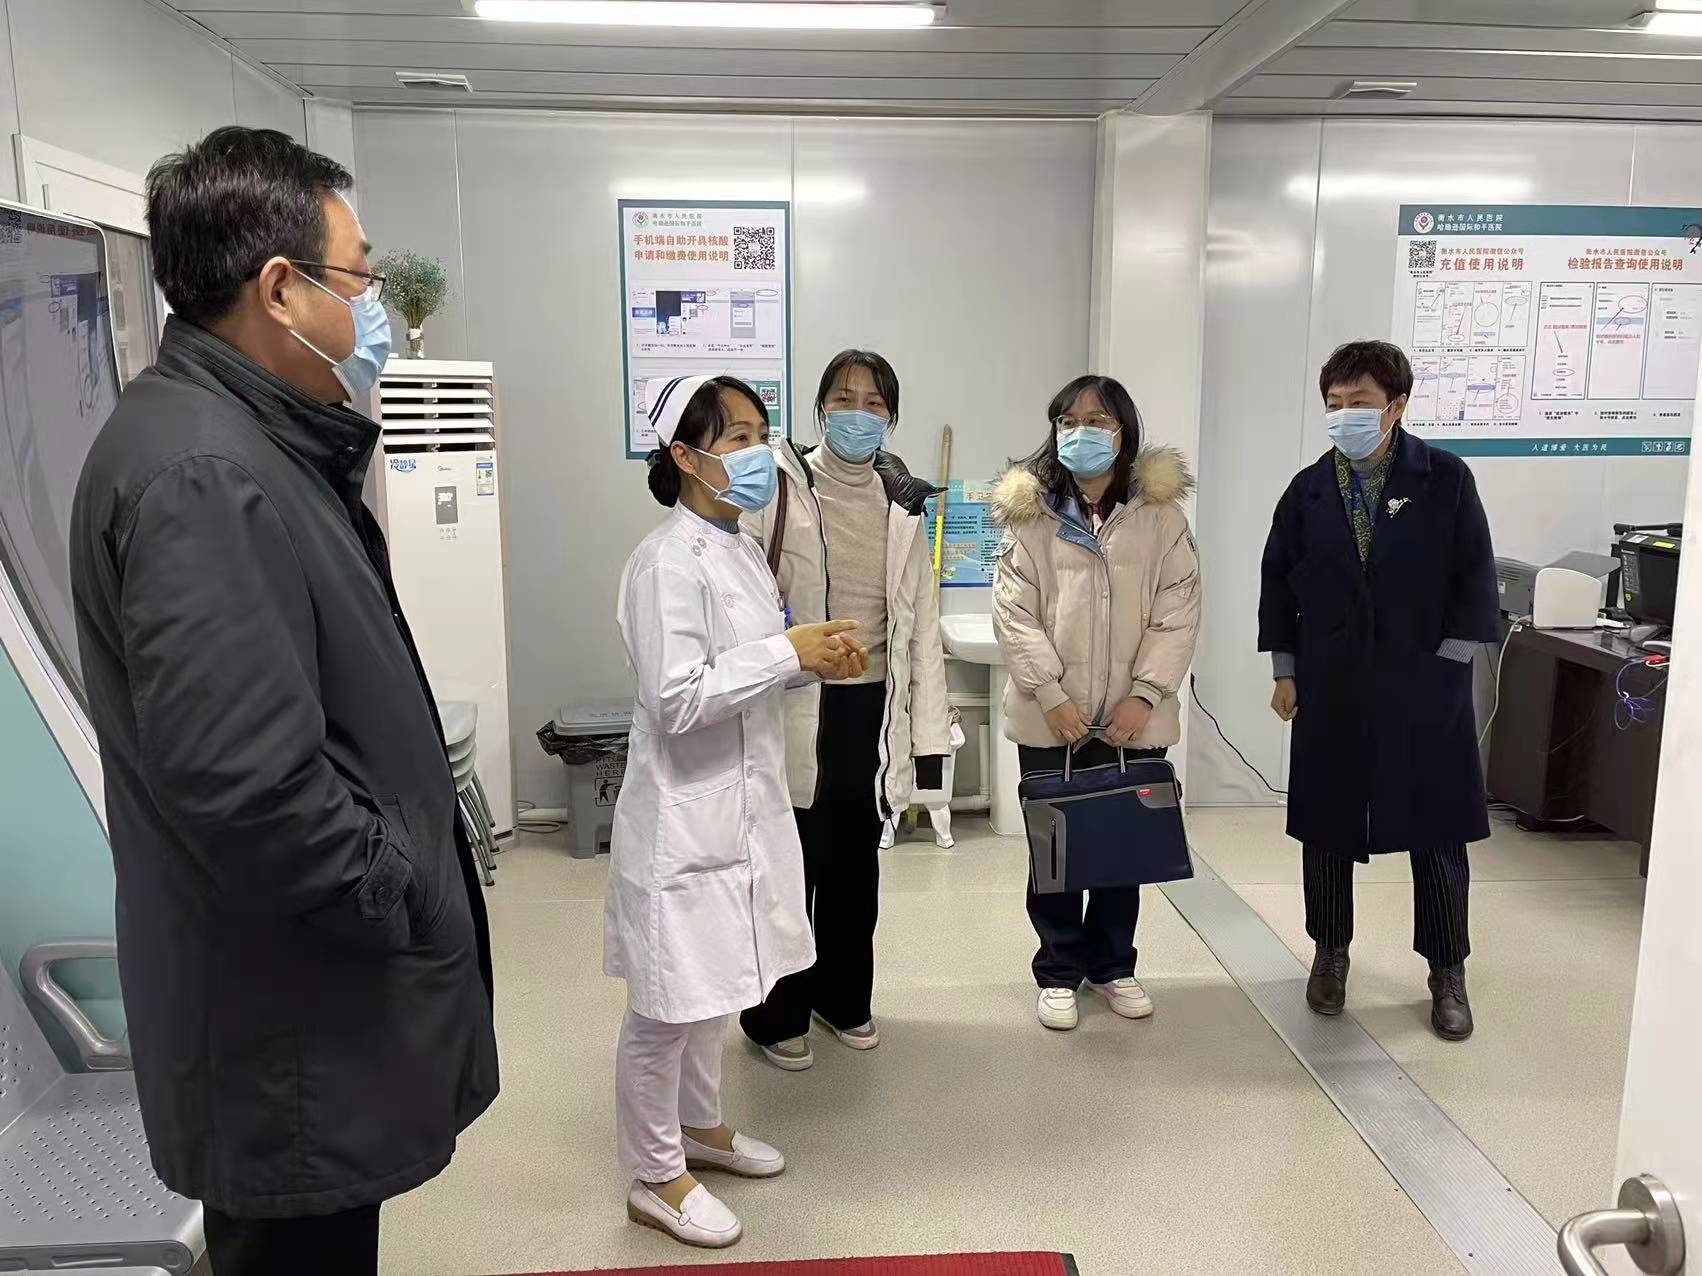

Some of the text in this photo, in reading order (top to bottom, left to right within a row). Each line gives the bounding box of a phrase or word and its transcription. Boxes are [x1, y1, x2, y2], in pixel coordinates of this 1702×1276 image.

[633, 234, 729, 246] 手机端自助开具核酸
[634, 250, 729, 262] 申请和缴费使用说明
[1440, 258, 1524, 271] 充值使用说明
[1567, 257, 1684, 271] 检验报告查询使用说明
